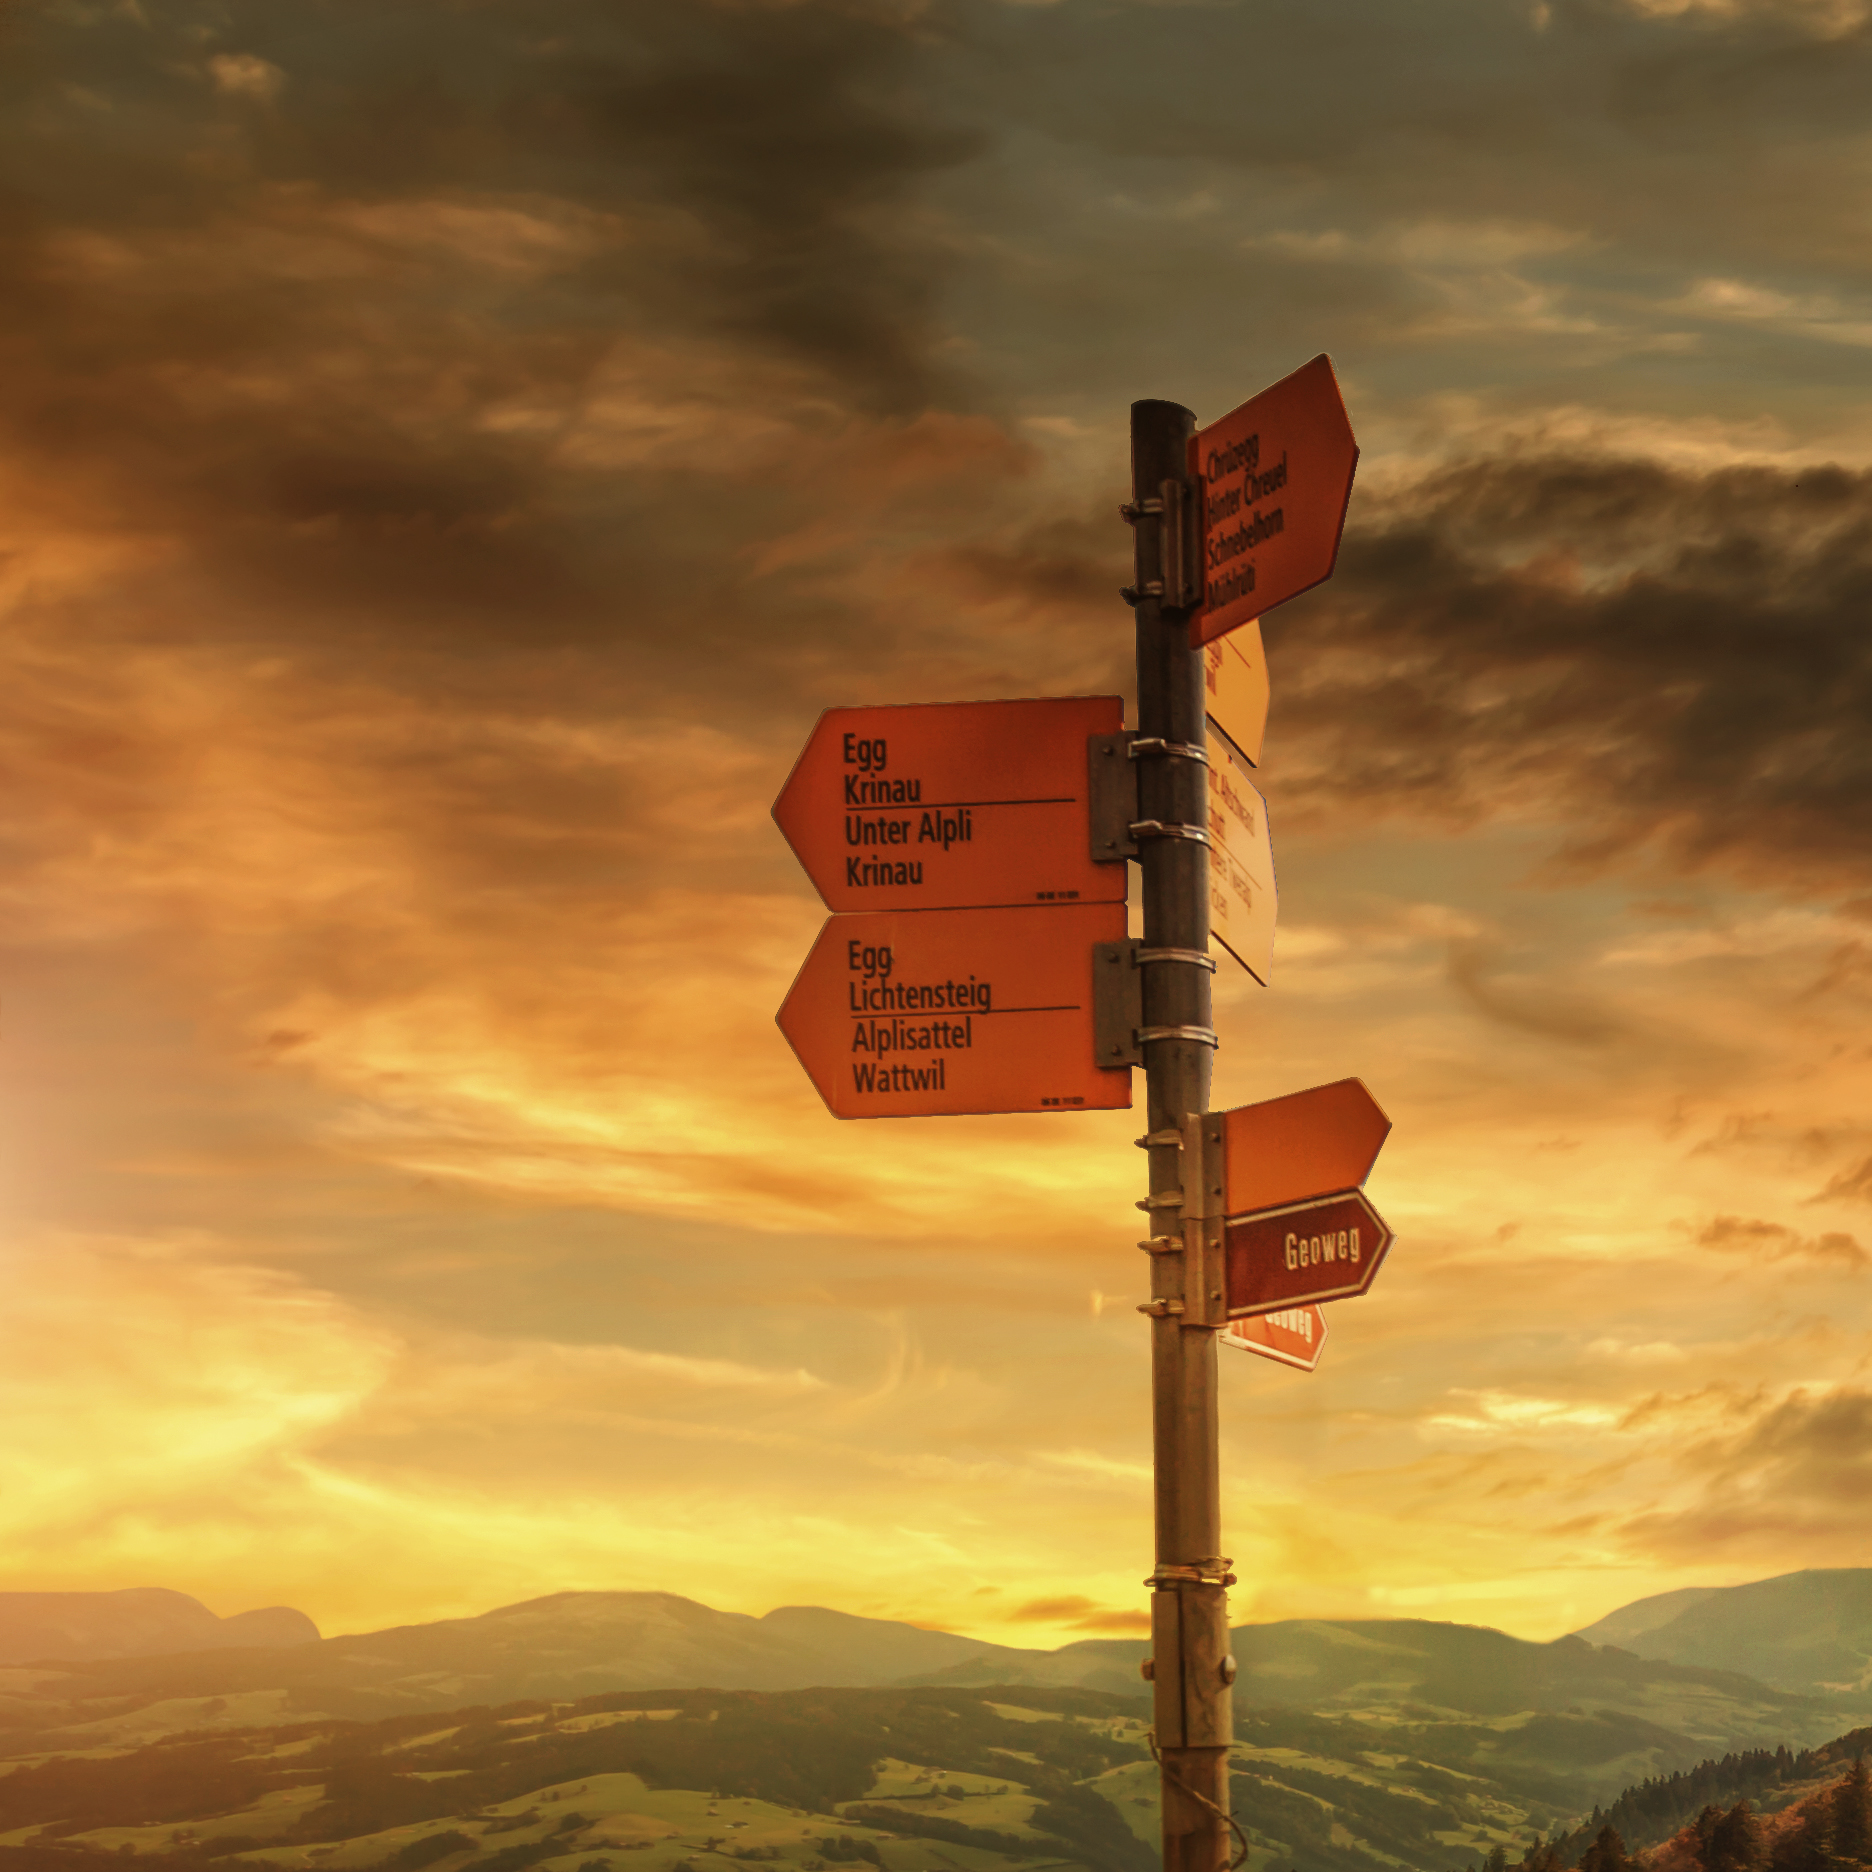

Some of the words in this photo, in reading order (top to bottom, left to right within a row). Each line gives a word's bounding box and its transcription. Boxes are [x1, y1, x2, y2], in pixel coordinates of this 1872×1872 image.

[843, 732, 887, 772] Egg
[844, 772, 922, 805] Krinau
[845, 814, 912, 846] Unter
[917, 808, 972, 852] Alpli
[846, 854, 924, 887] Krinau
[848, 940, 893, 979] Egg
[849, 975, 992, 1015] Lichtensteig
[852, 1015, 972, 1060] Alplisattel
[852, 1058, 946, 1093] Wattwil
[1285, 1227, 1360, 1271] Geoweg
